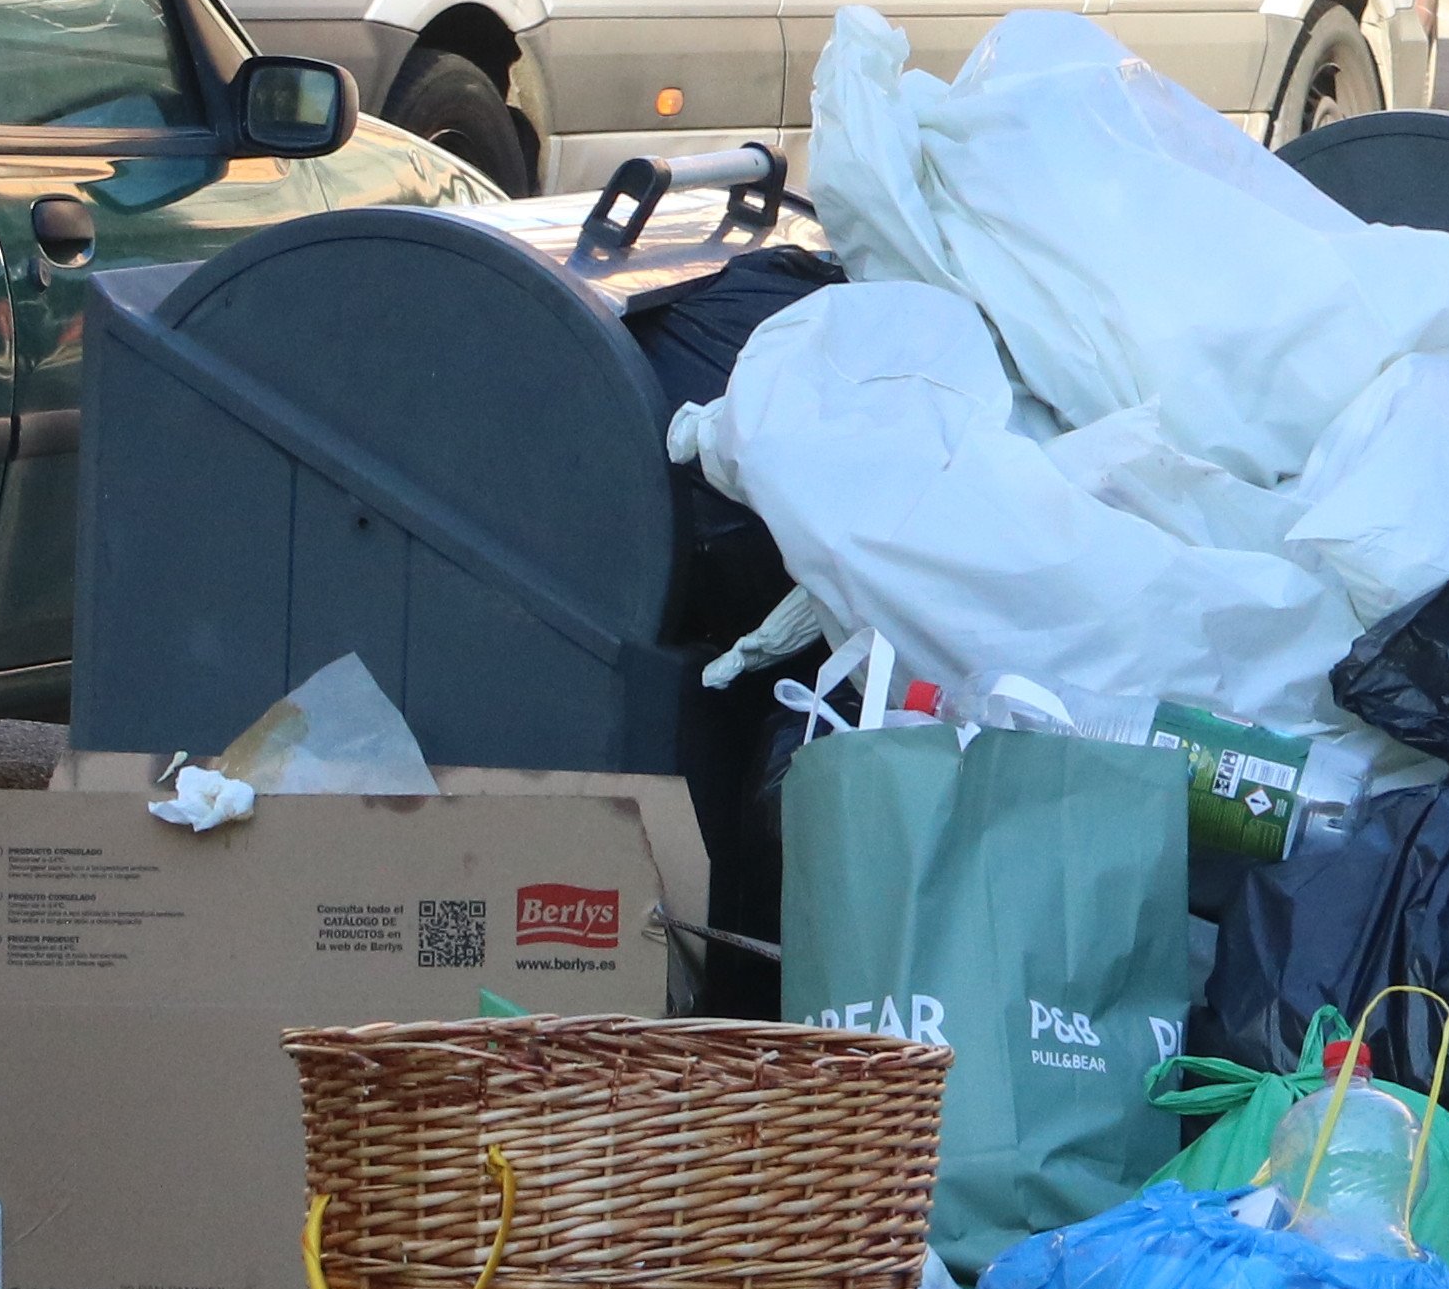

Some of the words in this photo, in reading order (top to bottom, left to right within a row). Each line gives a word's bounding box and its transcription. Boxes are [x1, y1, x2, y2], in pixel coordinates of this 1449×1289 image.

[323, 914, 379, 927] CATÁLOGO
[382, 917, 397, 927] DE
[520, 897, 615, 930] Berlys
[319, 929, 385, 940] PRODUCTOS
[388, 931, 401, 940] en
[329, 942, 352, 952] web
[354, 942, 368, 952] de
[370, 942, 404, 954] Berlys
[515, 957, 617, 973] www.berlys.es
[1029, 998, 1101, 1048] P&B
[1030, 1049, 1107, 1073] PULL&BEAR
